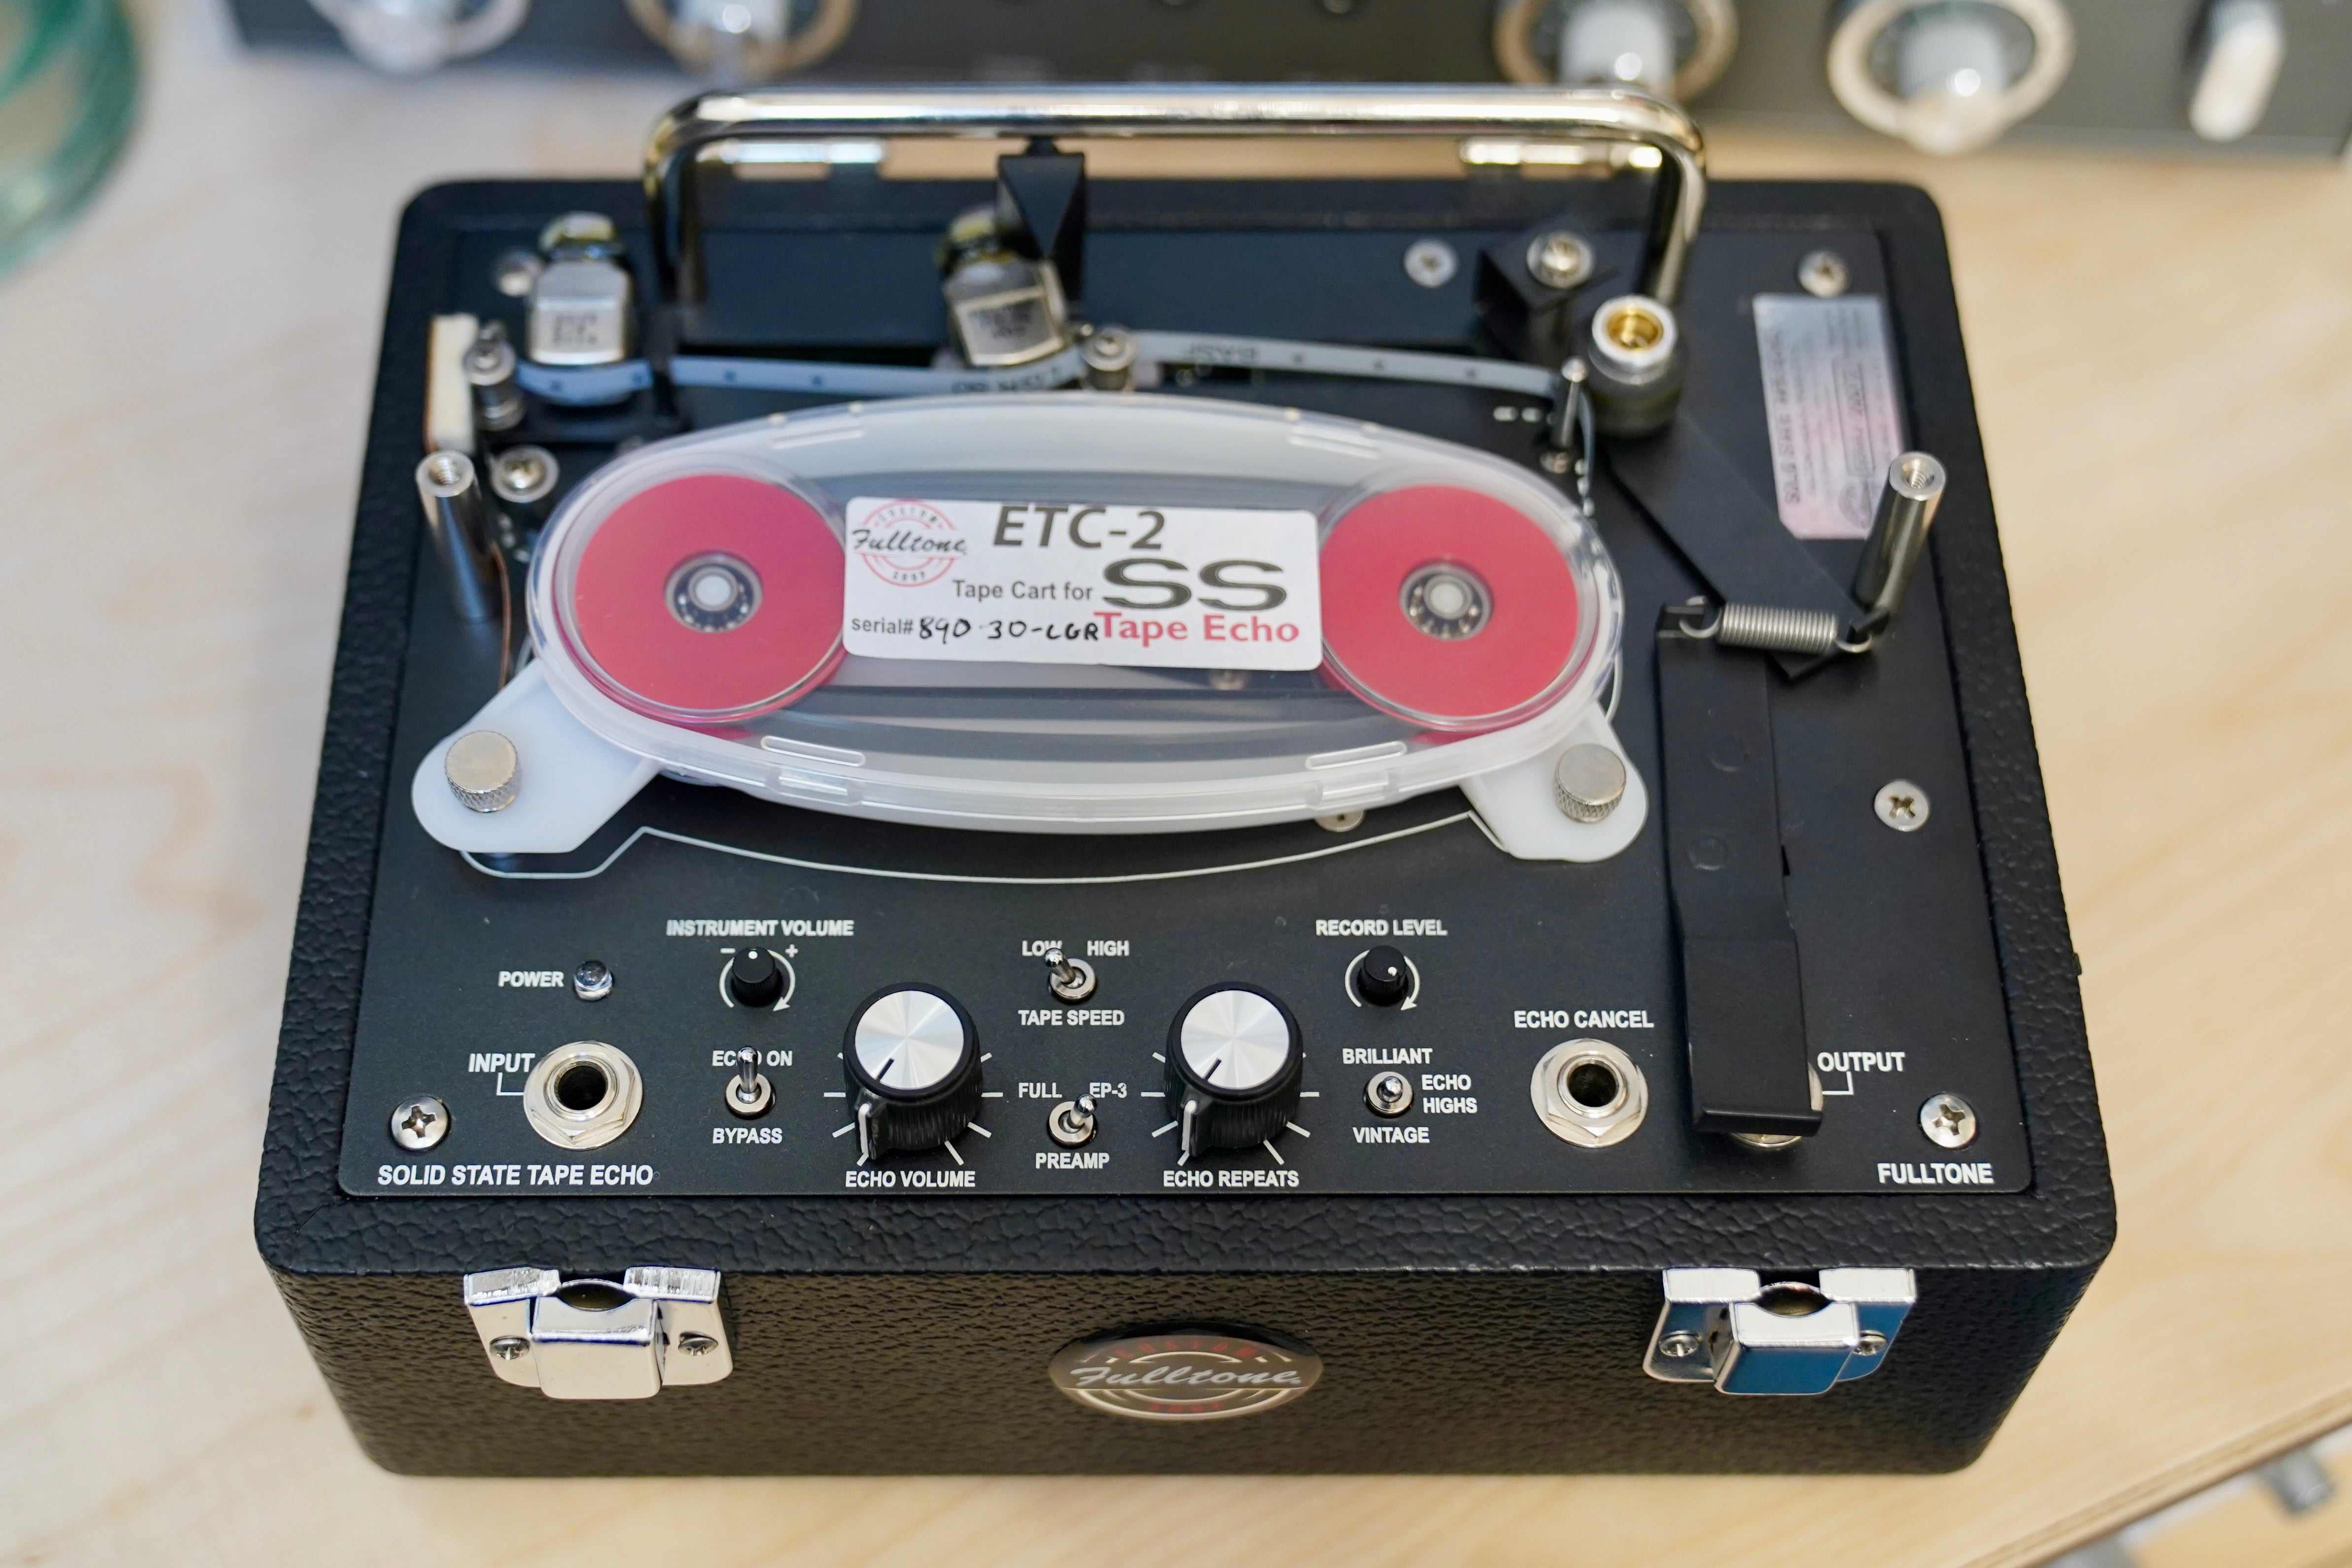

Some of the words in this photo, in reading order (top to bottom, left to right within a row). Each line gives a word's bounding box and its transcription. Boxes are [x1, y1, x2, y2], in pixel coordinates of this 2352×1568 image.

[992, 505, 1165, 551] ETC-2
[852, 529, 966, 556] Fulltone
[952, 580, 1003, 602] Tape
[1011, 581, 1056, 599] Cart
[1064, 582, 1093, 600] for
[1102, 558, 1287, 611] SS
[1093, 612, 1188, 648] Tape
[1203, 614, 1299, 643] Echo
[666, 920, 778, 937] INSTRUMENT
[780, 920, 854, 937] VOLUME
[1315, 919, 1389, 936] RECORD
[1393, 919, 1448, 936] LEVEL
[1087, 940, 1130, 956] HIGH
[498, 971, 564, 987] POWER
[1018, 1010, 1063, 1026] TAPE
[1066, 1010, 1125, 1026] SPEED
[1514, 1011, 1570, 1028] ECHO
[1574, 1010, 1654, 1028] CANCEL
[468, 1053, 535, 1073] INPUT
[712, 1050, 762, 1067] EC
[766, 1050, 793, 1067] ON
[1342, 1047, 1433, 1064] BRILLIANT
[1817, 1051, 1905, 1072] OUTPUT
[1018, 1082, 1062, 1098] FULL
[1089, 1082, 1127, 1099] EP-3
[1421, 1074, 1472, 1091] ECHO
[1423, 1097, 1478, 1114] HIGHS
[712, 1127, 783, 1144] BYPASS
[1352, 1126, 1430, 1144] VINTAGE
[1035, 1152, 1110, 1169] PREAMP
[378, 1165, 446, 1185] SOLID
[451, 1164, 522, 1185] STATE
[527, 1164, 585, 1185] TAPE
[590, 1164, 653, 1185] ECHO
[845, 1170, 896, 1188] ECHO
[900, 1170, 976, 1187] VOLUME
[1163, 1170, 1214, 1187] ECHO
[1218, 1170, 1299, 1187] REPEATS
[1877, 1163, 1995, 1184] FULLTONE
[1069, 1365, 1302, 1386] Fulltone
